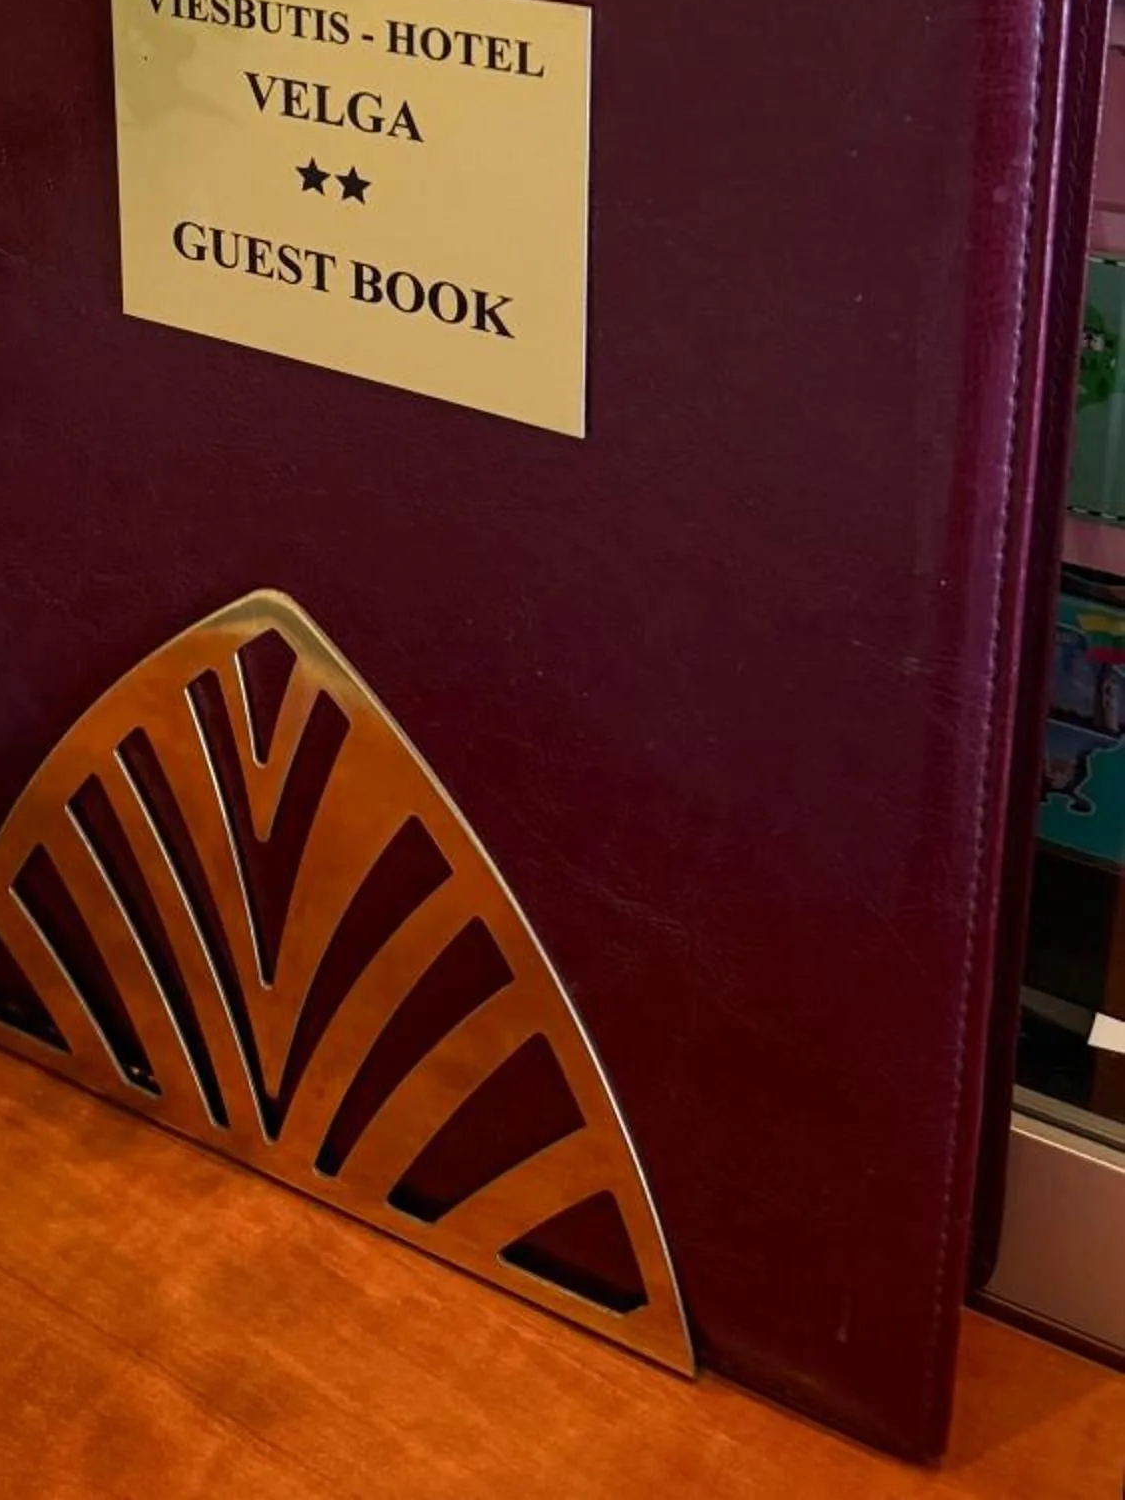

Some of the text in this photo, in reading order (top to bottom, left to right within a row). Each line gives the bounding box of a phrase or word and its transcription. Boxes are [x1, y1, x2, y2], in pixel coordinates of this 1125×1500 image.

[385, 19, 545, 78] HOTEL
[244, 71, 425, 143] VELGA
[172, 219, 516, 339] GUEST BOOK
